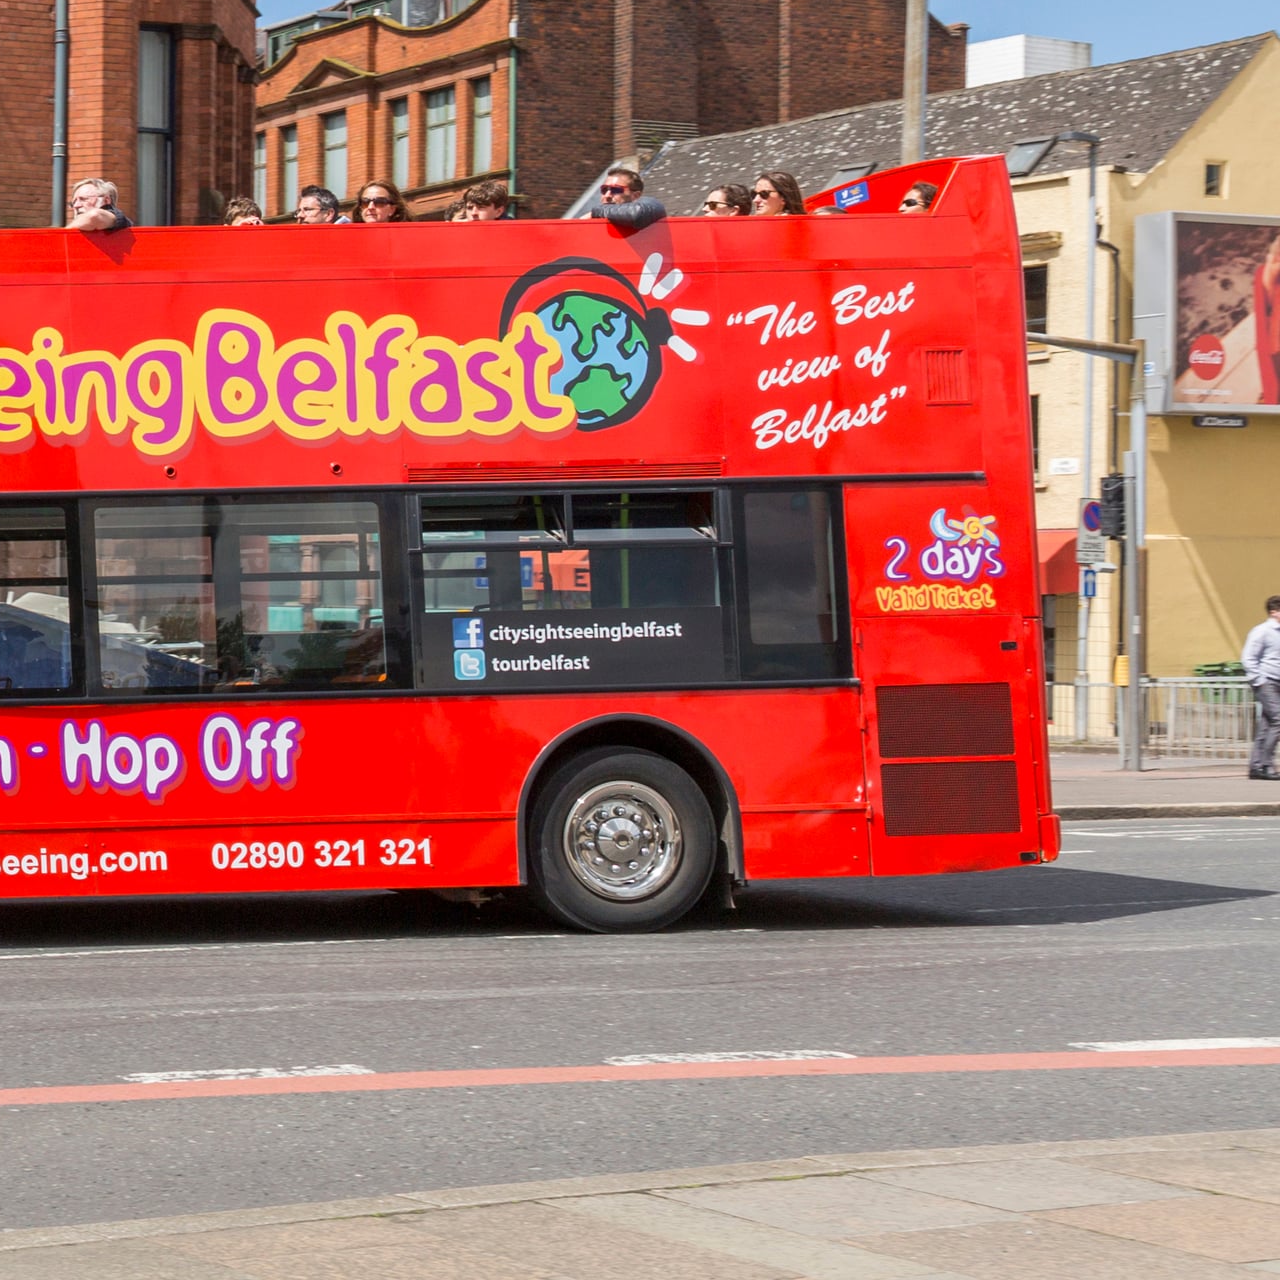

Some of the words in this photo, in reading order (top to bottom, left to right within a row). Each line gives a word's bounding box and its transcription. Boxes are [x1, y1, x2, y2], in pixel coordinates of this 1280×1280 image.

[831, 281, 915, 325] Best
[757, 354, 841, 391] view
[854, 329, 891, 377] of
[885, 536, 910, 581] 2
[919, 537, 1006, 583] days
[489, 622, 682, 645] citysightseeingbelfast
[491, 654, 590, 672] tourbelfast
[62, 720, 183, 798] Hop
[201, 714, 301, 784] Off
[211, 842, 305, 870] 02890
[314, 840, 366, 868] 321
[379, 838, 432, 866] 321
